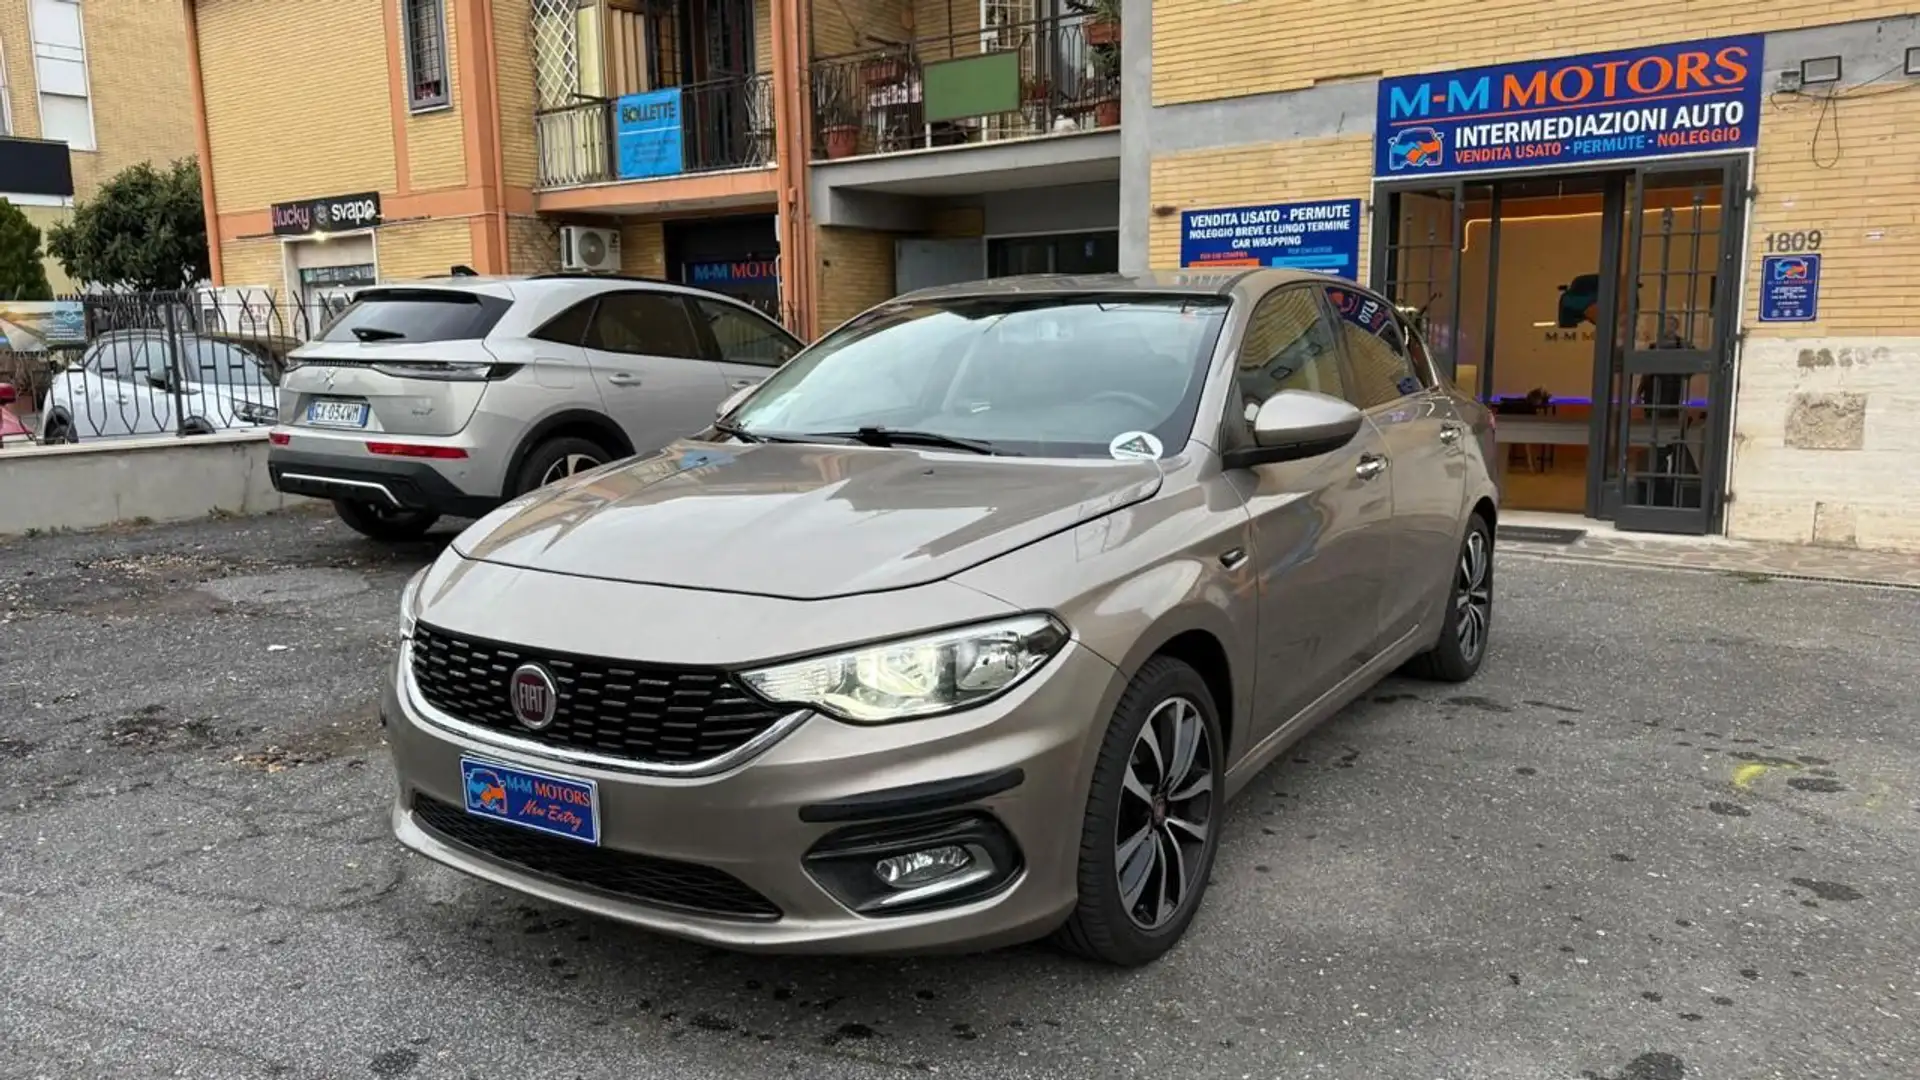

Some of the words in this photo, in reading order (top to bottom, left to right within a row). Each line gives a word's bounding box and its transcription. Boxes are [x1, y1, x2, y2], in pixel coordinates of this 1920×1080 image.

[1390, 76, 1491, 119] M-M
[1503, 47, 1748, 109] MOTORS
[622, 102, 676, 124] BOLLETTE
[1455, 108, 1667, 148] INTERMEDIAZIONI
[1672, 101, 1744, 129] AUTO
[1454, 147, 1512, 164] VENDITA
[1515, 142, 1561, 158] USATO
[1573, 135, 1645, 155] PERMUTE
[1657, 128, 1740, 148] NOLEGGIO
[331, 200, 376, 225] svapo
[1190, 213, 1239, 228] VENDITA
[1241, 210, 1280, 225] USATO
[1290, 204, 1351, 221] PERMUTE
[1189, 228, 1233, 240] NOLEGGIO
[1235, 225, 1264, 237] BREVE
[1266, 225, 1272, 235] E
[1273, 222, 1305, 235] LUNGO
[1307, 219, 1350, 232] TERMINE
[1232, 238, 1250, 249] CAR
[1252, 235, 1301, 248] WRAPPING
[1765, 230, 1822, 252] 1809
[694, 263, 728, 280] M-M
[520, 682, 544, 712] FIAT
[507, 775, 532, 793] M-M
[534, 782, 590, 806] MOTORS
[547, 805, 584, 832] Entry
